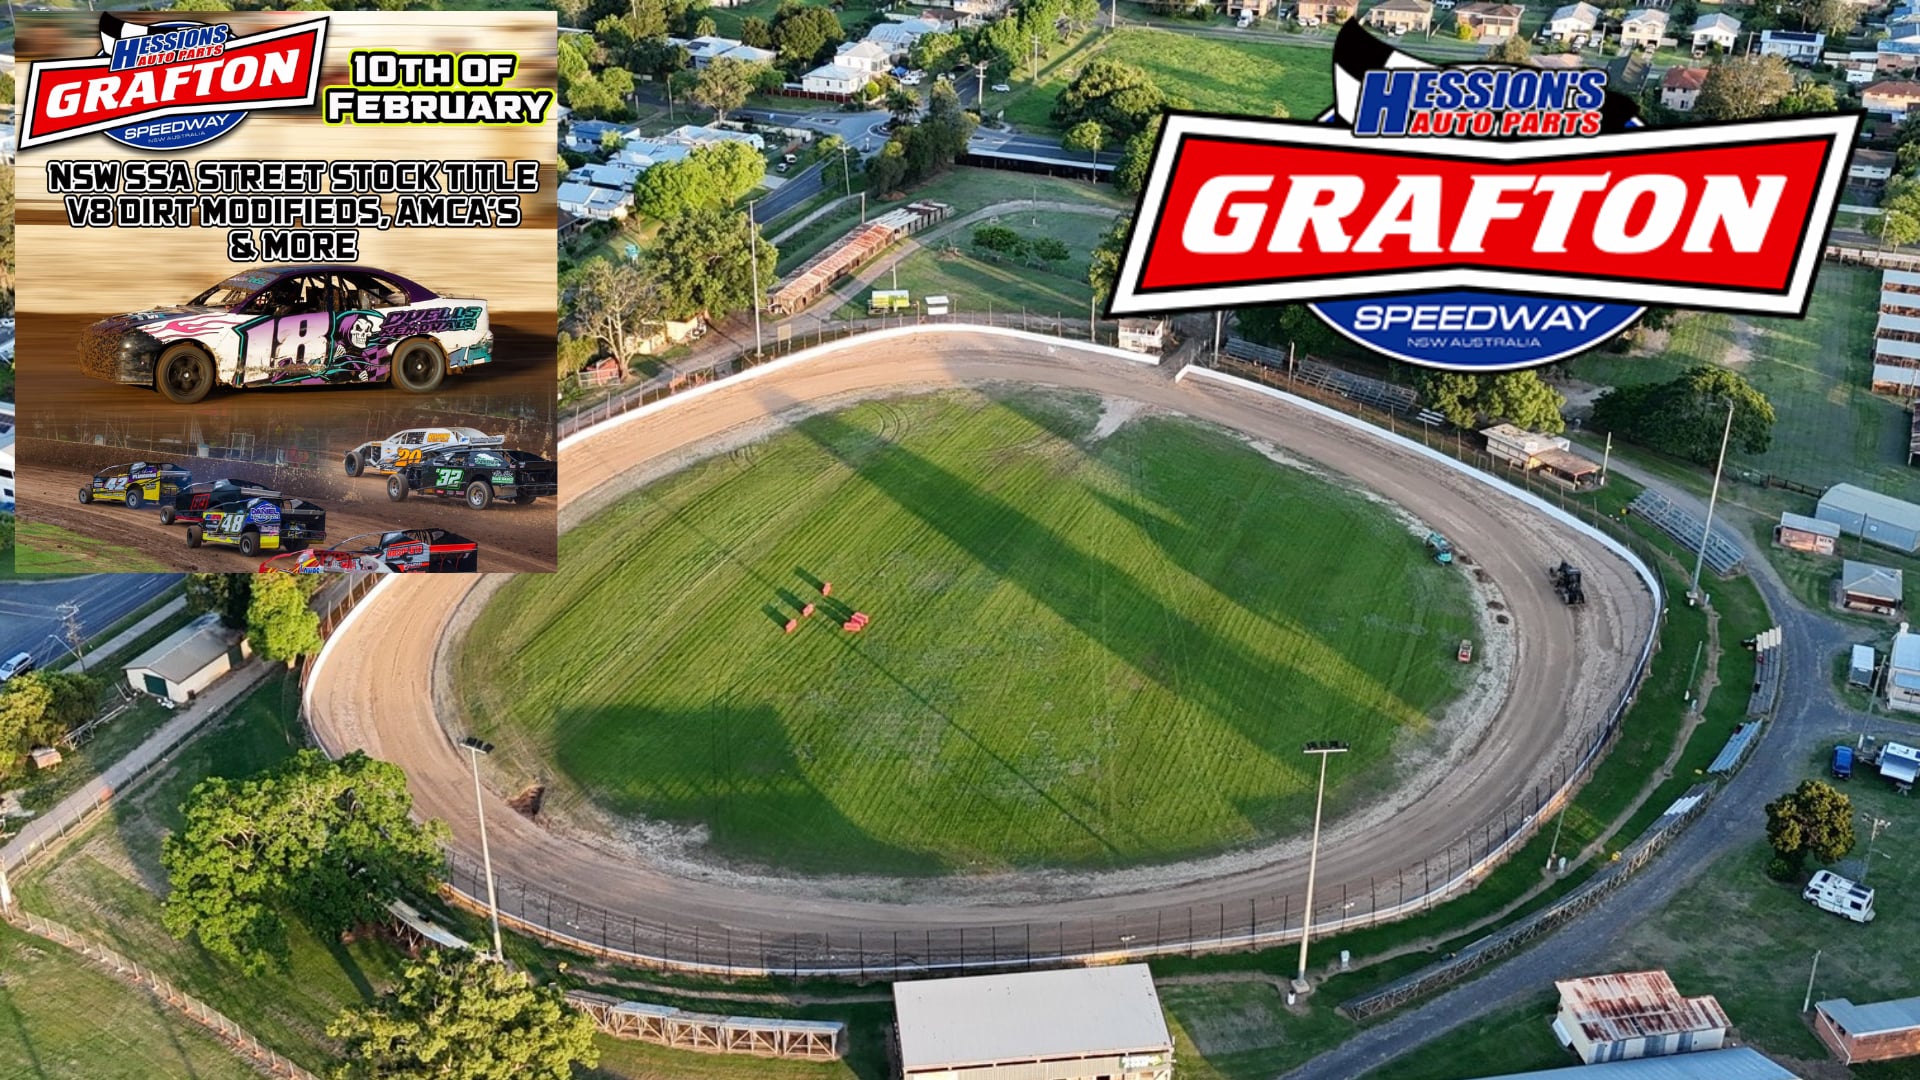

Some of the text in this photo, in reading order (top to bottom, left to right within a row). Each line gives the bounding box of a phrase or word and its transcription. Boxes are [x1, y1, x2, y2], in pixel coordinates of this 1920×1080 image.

[243, 312, 331, 383] 18
[104, 477, 129, 491] 42
[251, 507, 279, 515] DANIEL
[222, 513, 245, 532] 48
